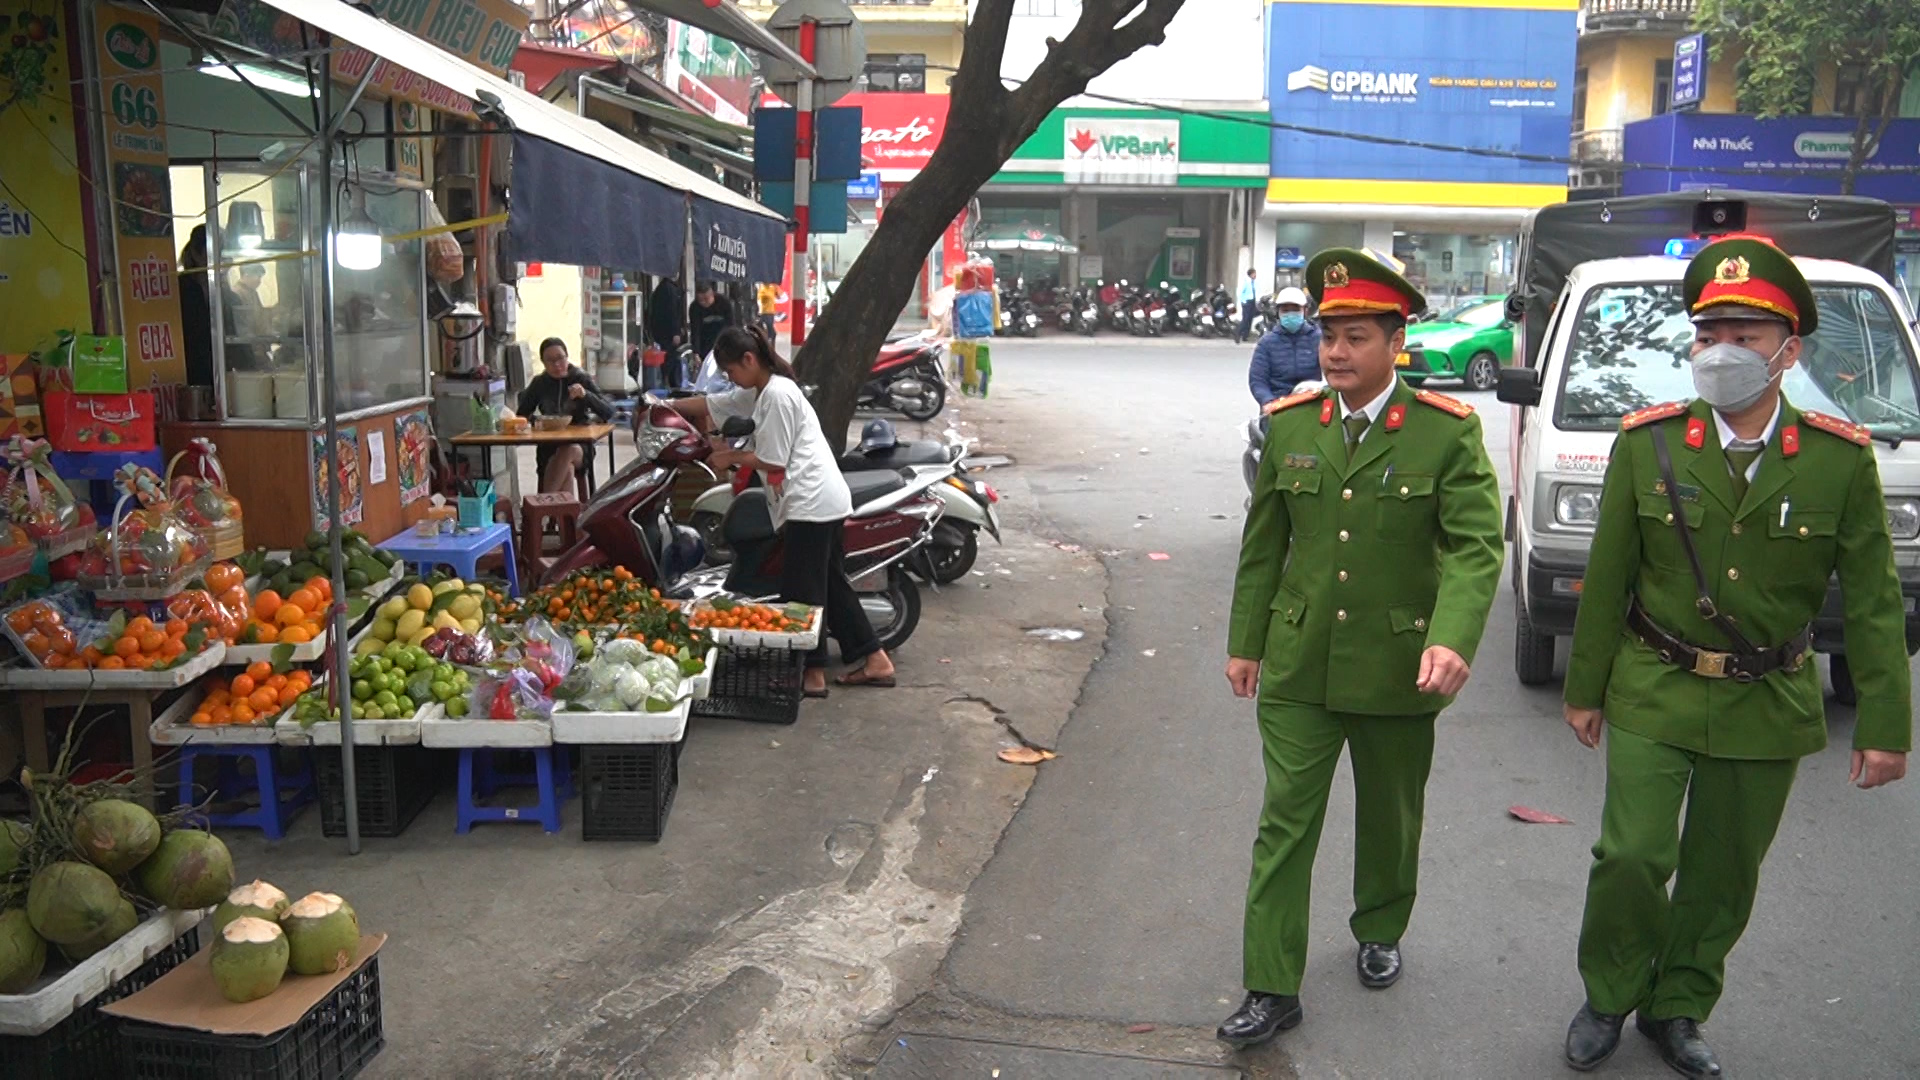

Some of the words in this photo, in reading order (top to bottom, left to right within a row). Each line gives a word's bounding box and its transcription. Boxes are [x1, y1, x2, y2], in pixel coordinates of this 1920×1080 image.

[1330, 71, 1418, 94] GPBANK
[111, 82, 158, 130] 66
[1100, 134, 1176, 156] VPBank
[139, 323, 174, 361] CUA
